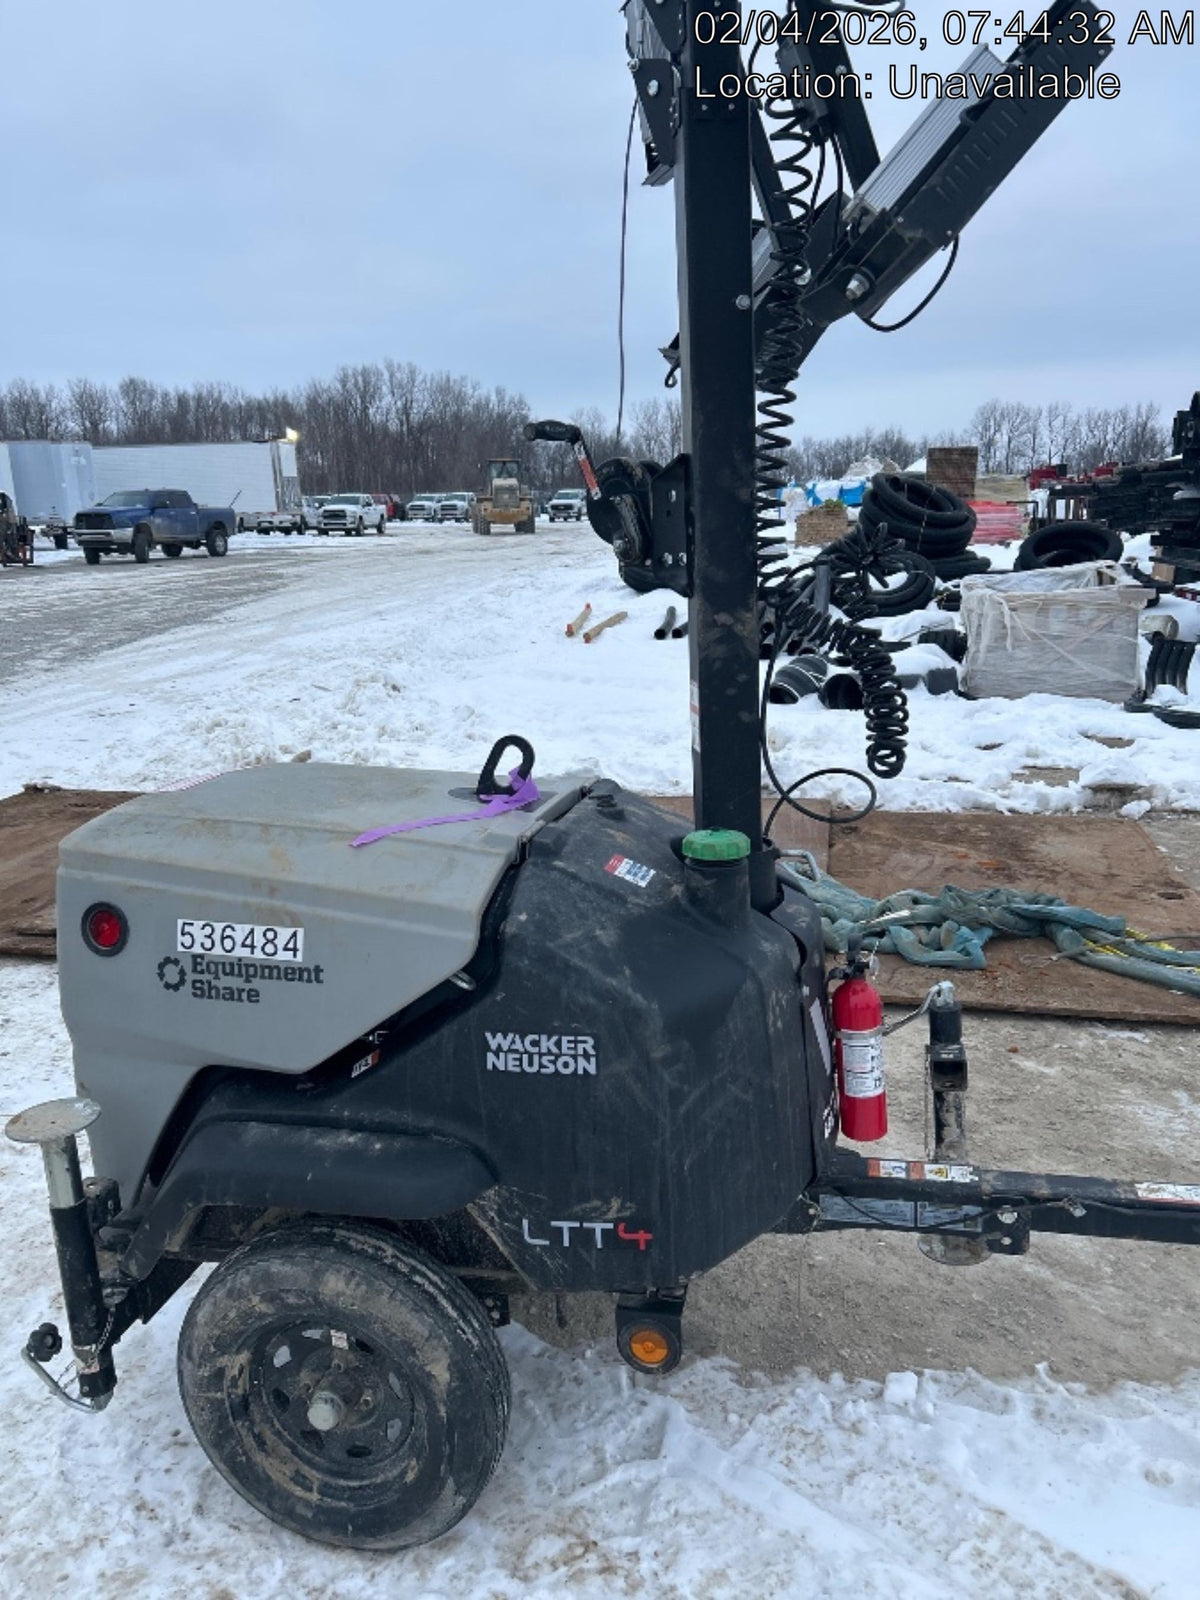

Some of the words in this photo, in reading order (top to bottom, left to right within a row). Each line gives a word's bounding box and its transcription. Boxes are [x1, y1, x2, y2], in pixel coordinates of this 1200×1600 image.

[180, 922, 300, 959] 536484
[191, 954, 324, 984] Equipment
[191, 979, 260, 1003] Share
[485, 1032, 597, 1055] WACKER
[486, 1052, 597, 1075] NEUSON
[522, 1218, 653, 1250] LTT4
